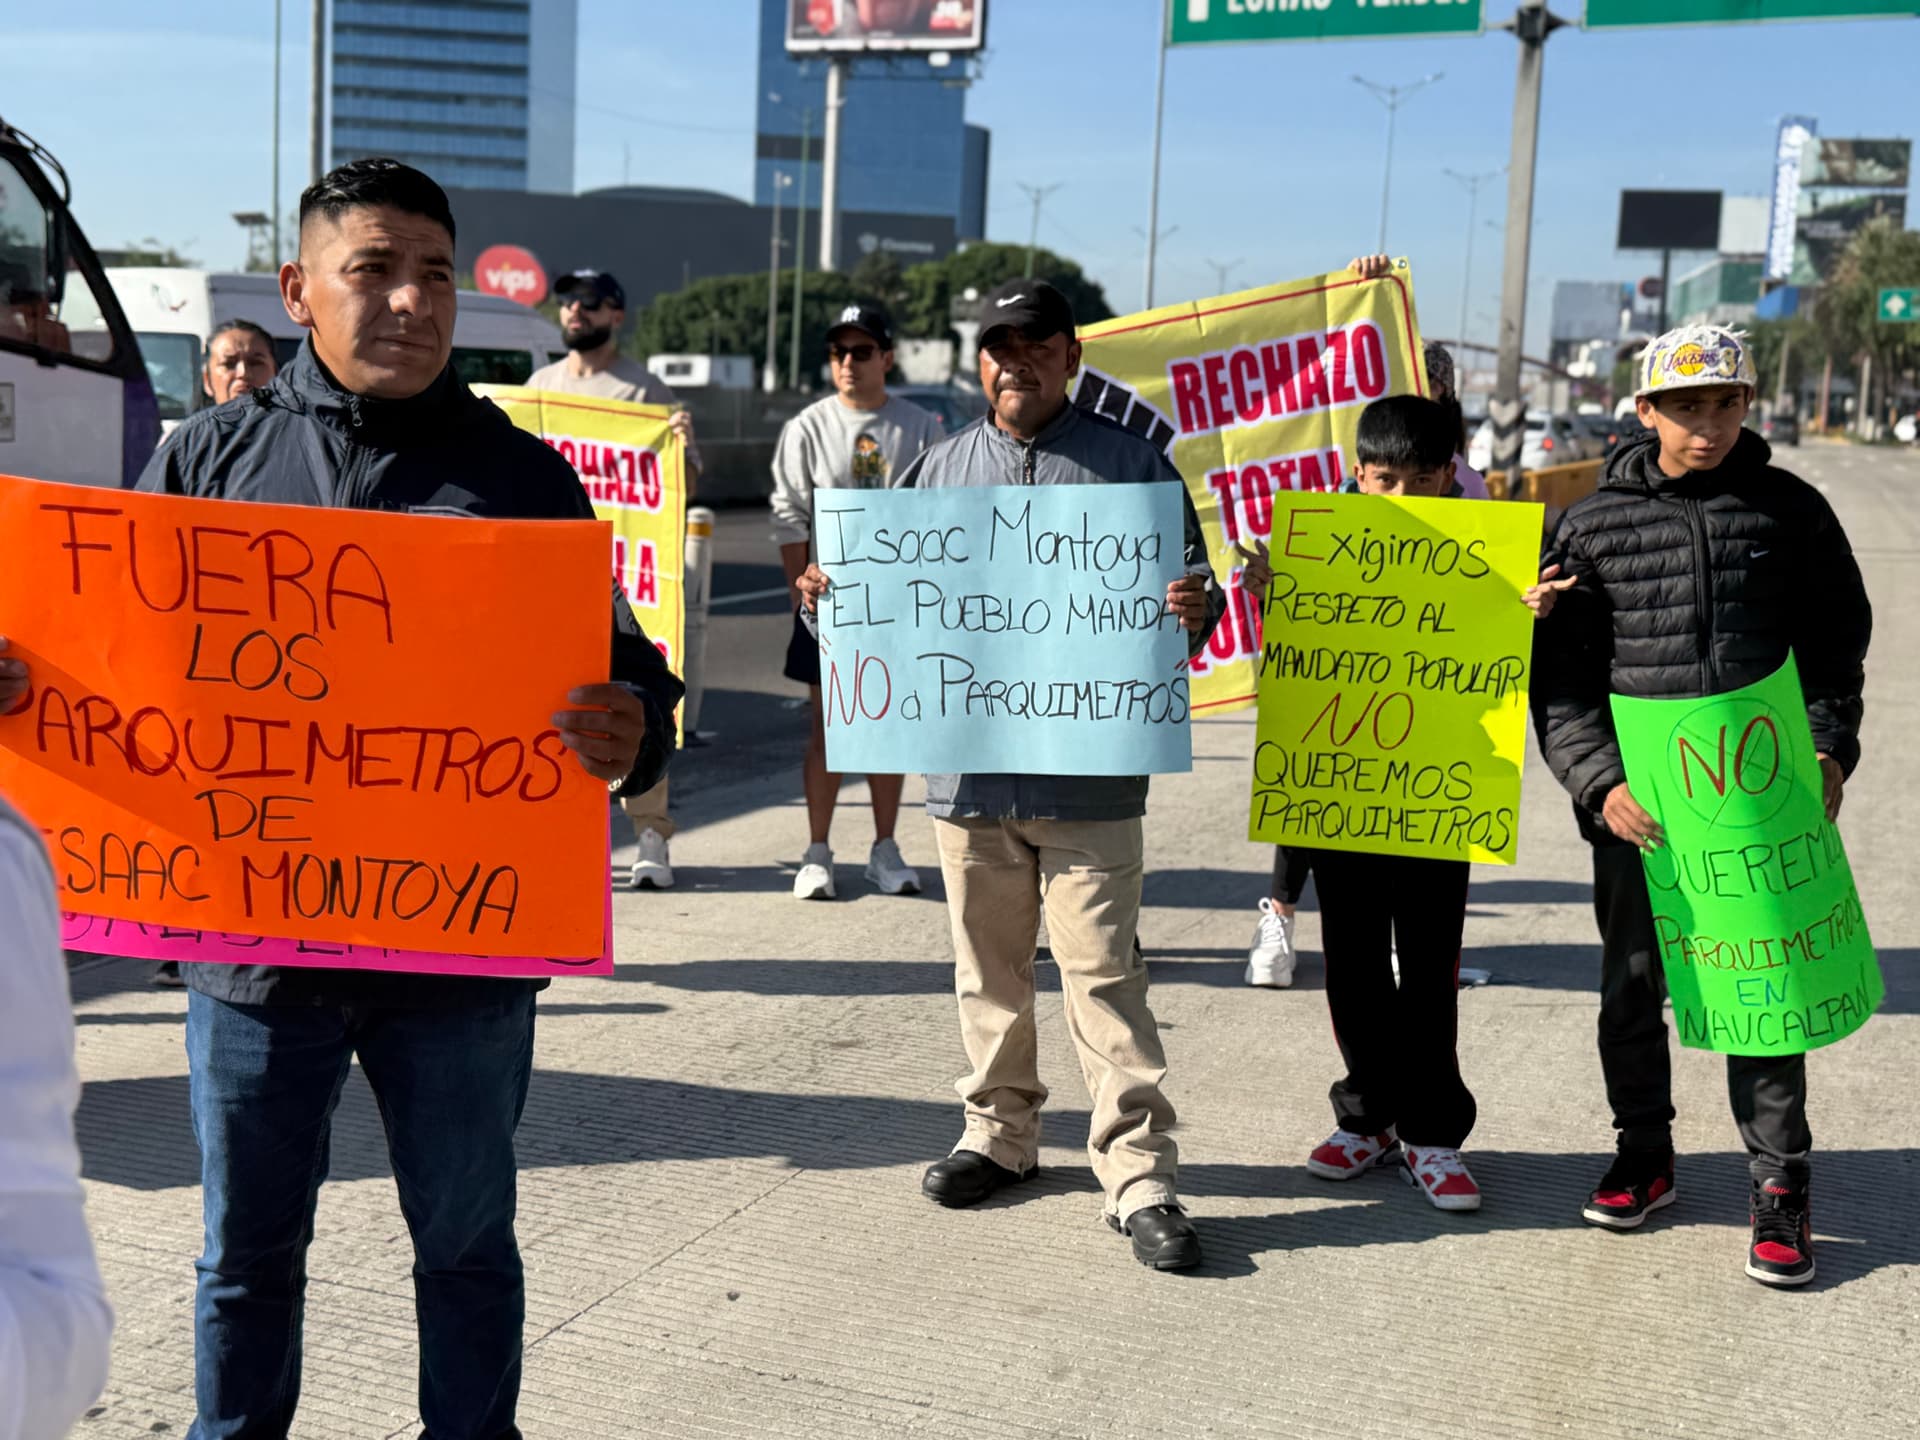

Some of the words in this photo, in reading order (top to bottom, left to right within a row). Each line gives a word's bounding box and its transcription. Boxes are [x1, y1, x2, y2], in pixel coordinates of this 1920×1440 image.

[486, 261, 537, 298] vips
[1170, 324, 1386, 433] RECHAZO
[40, 502, 394, 644] FUERA
[821, 507, 969, 568] Isaac
[989, 500, 1161, 591] Montoya
[832, 582, 895, 629] EL
[907, 579, 1051, 635] PUEBLO
[1065, 592, 1180, 635] MANDA
[1266, 572, 1407, 627] RESPETO
[1416, 602, 1455, 633] AL
[184, 623, 329, 701] LOS
[1259, 642, 1391, 684] MANDATO
[1404, 651, 1525, 707] POPULAR
[1301, 691, 1414, 750] NO
[1254, 741, 1473, 801] QUEREMOS
[1678, 715, 1780, 798] NO
[195, 789, 314, 842] DE
[1253, 789, 1513, 852] PARQUIMETROS
[43, 826, 210, 901] SAAC
[241, 851, 520, 934] MONTOYA
[1736, 973, 1788, 1007] EN
